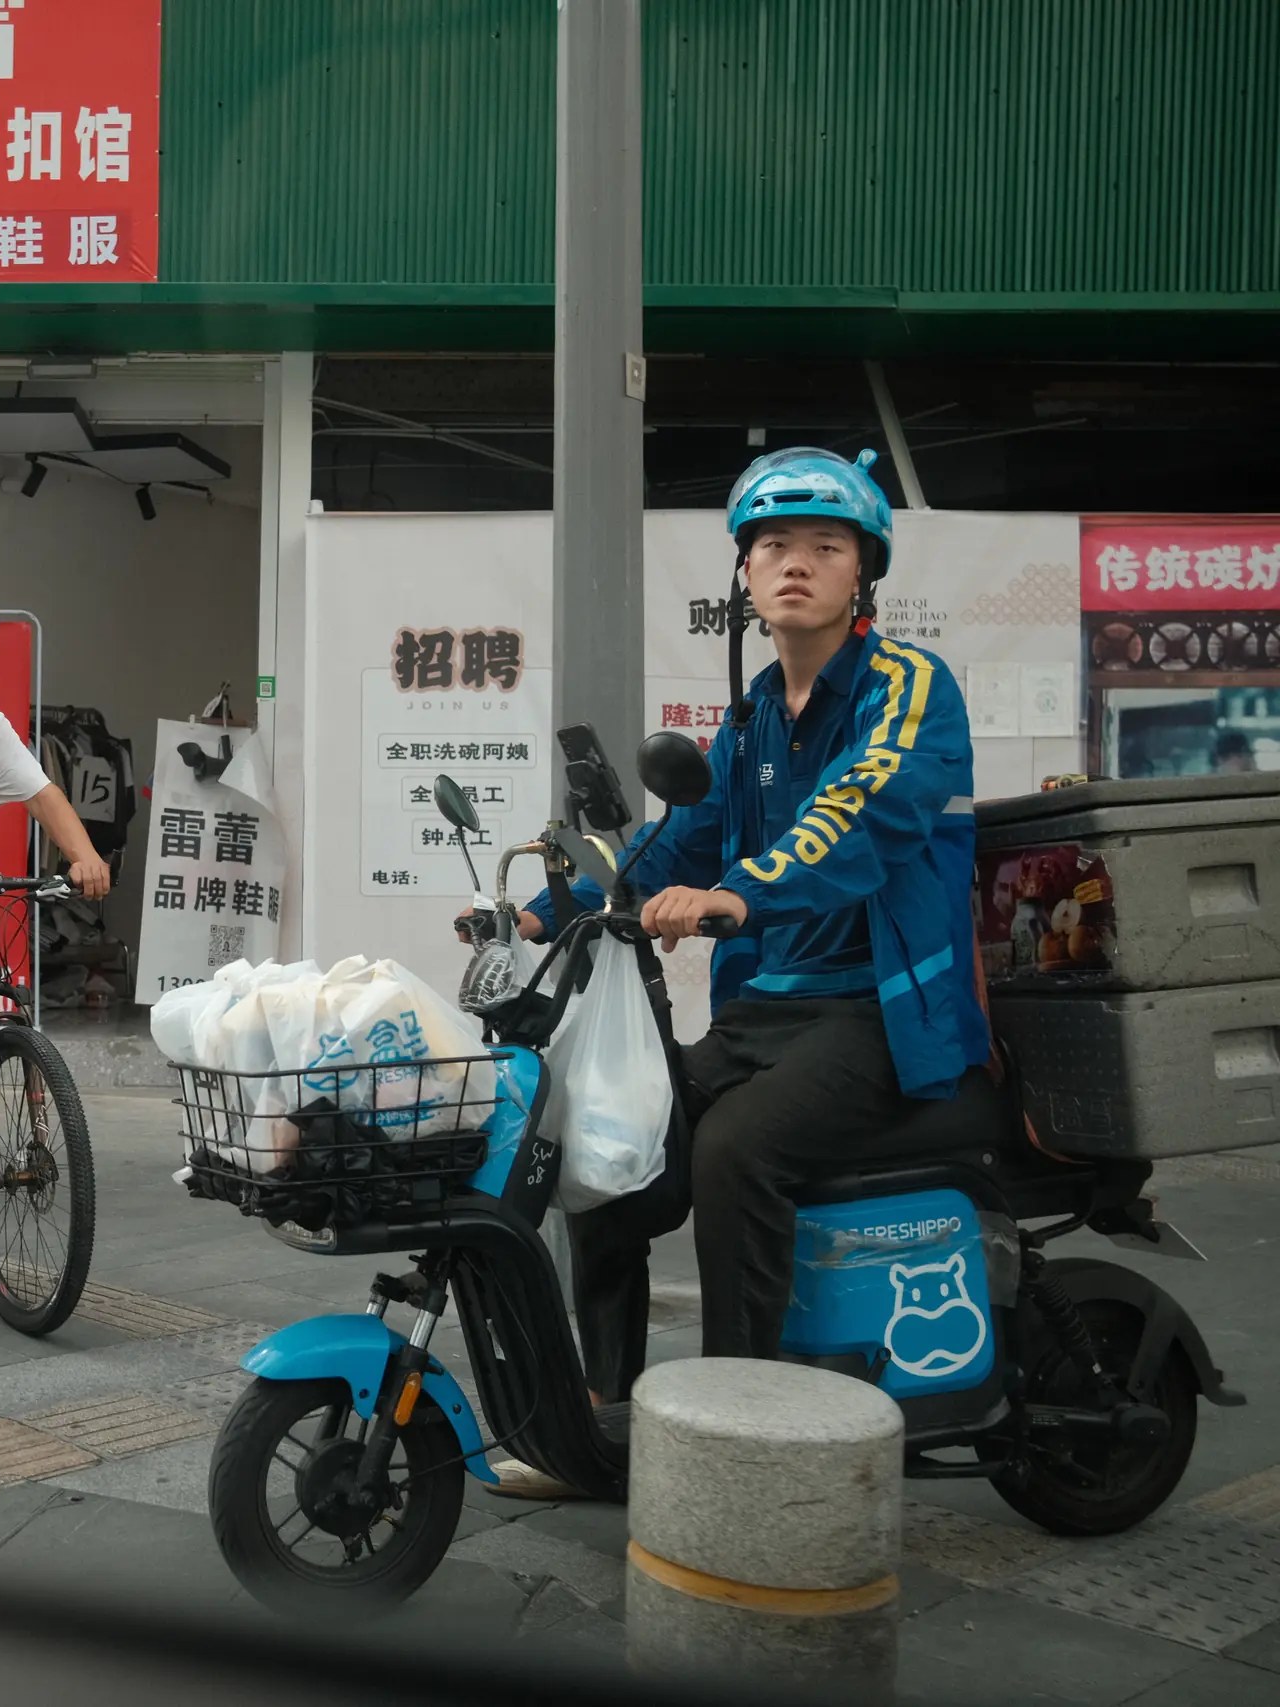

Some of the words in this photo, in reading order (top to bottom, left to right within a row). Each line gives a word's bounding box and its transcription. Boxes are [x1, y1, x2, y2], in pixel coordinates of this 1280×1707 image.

[885, 598, 908, 609] CAI
[912, 598, 927, 610] QI
[885, 610, 915, 622] ZHU
[919, 610, 947, 624] JIAO
[394, 629, 521, 690] 招聘
[406, 701, 463, 710] JOIN
[482, 701, 509, 710] US
[660, 703, 725, 728] 隆江
[385, 742, 530, 761] 全职洗碗阿姨
[80, 770, 111, 804] 15
[410, 785, 505, 803] 全员工
[160, 807, 259, 866] 雷蕾
[421, 827, 493, 846] 钟点工
[863, 1216, 962, 1241] FRESHIPPO
